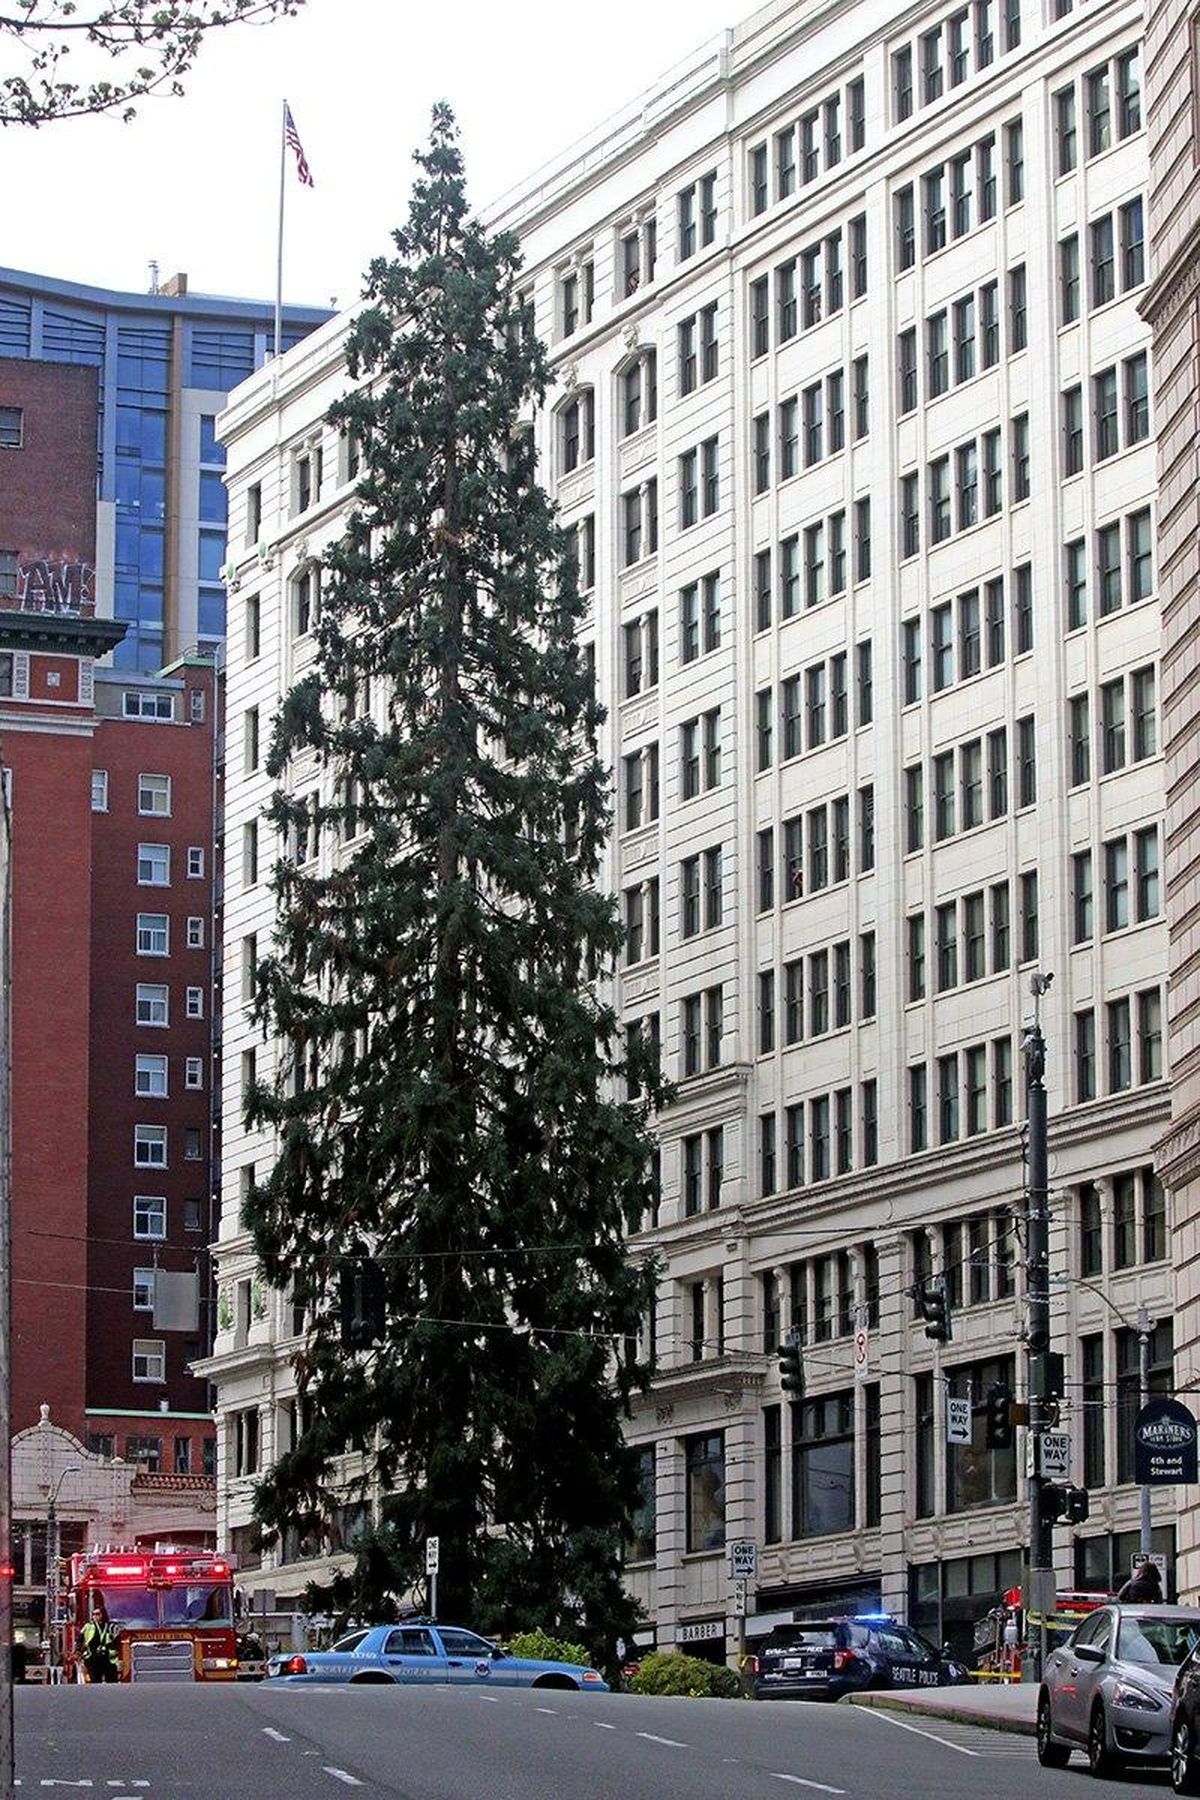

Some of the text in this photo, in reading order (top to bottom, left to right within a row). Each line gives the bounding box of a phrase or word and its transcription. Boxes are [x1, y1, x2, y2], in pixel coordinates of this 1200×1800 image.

[950, 1403, 968, 1413] ONE
[951, 1415, 968, 1425] WAY
[1044, 1437, 1067, 1448] ONE
[1044, 1449, 1067, 1460] WAY
[1150, 1456, 1183, 1465] 4th and
[1150, 1467, 1183, 1476] Stewart
[734, 1546, 754, 1555] ONE
[735, 1556, 754, 1565] WAY
[682, 1624, 717, 1640] BARBER
[891, 1666, 939, 1686] SEATTLE POLICE
